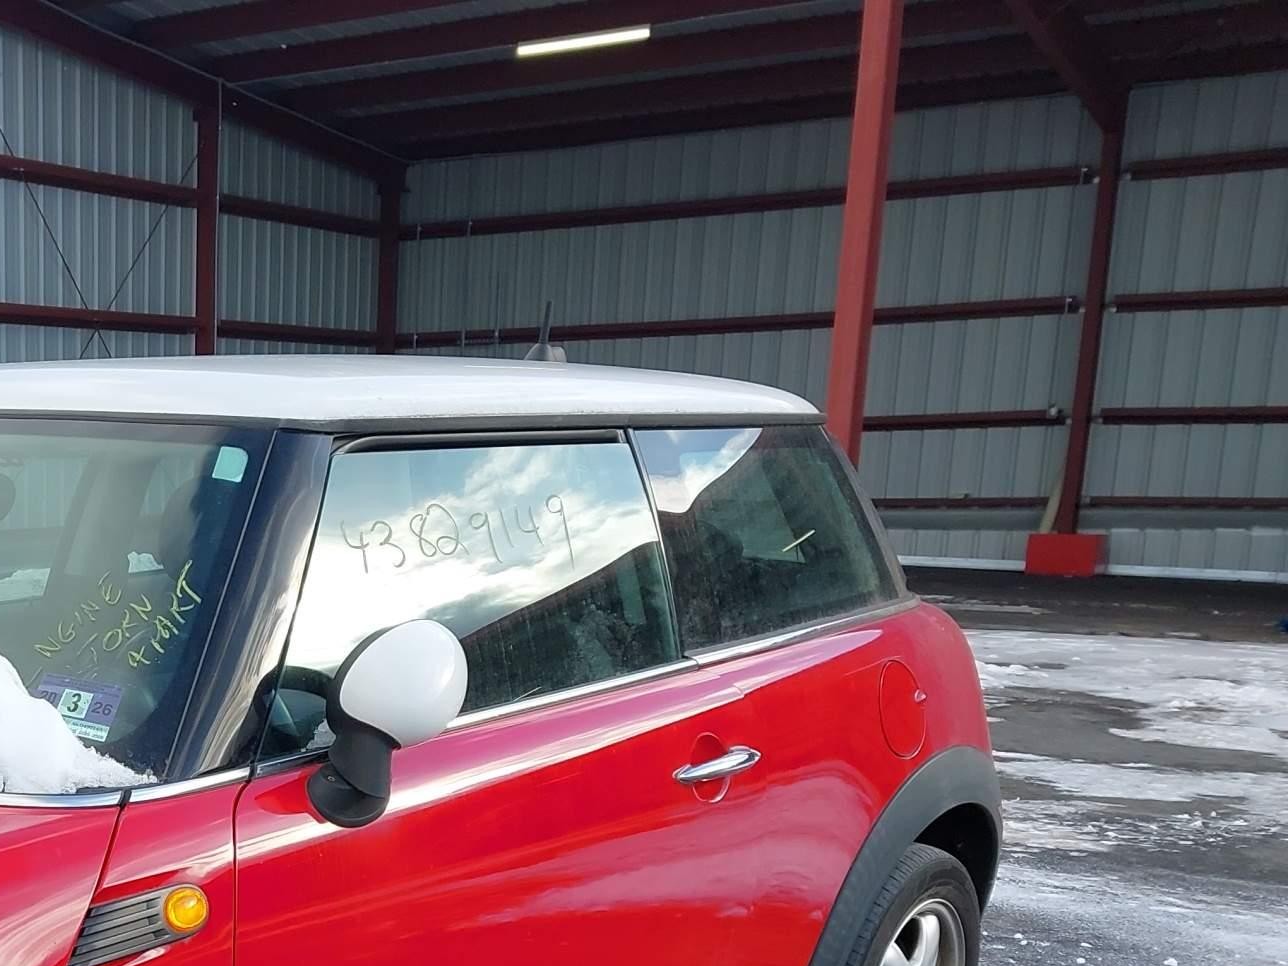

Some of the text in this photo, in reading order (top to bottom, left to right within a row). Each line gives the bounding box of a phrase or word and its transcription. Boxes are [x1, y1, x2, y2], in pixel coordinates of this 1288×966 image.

[340, 494, 574, 574] 43829149
[66, 692, 83, 713] 3
[90, 701, 114, 717] 26
